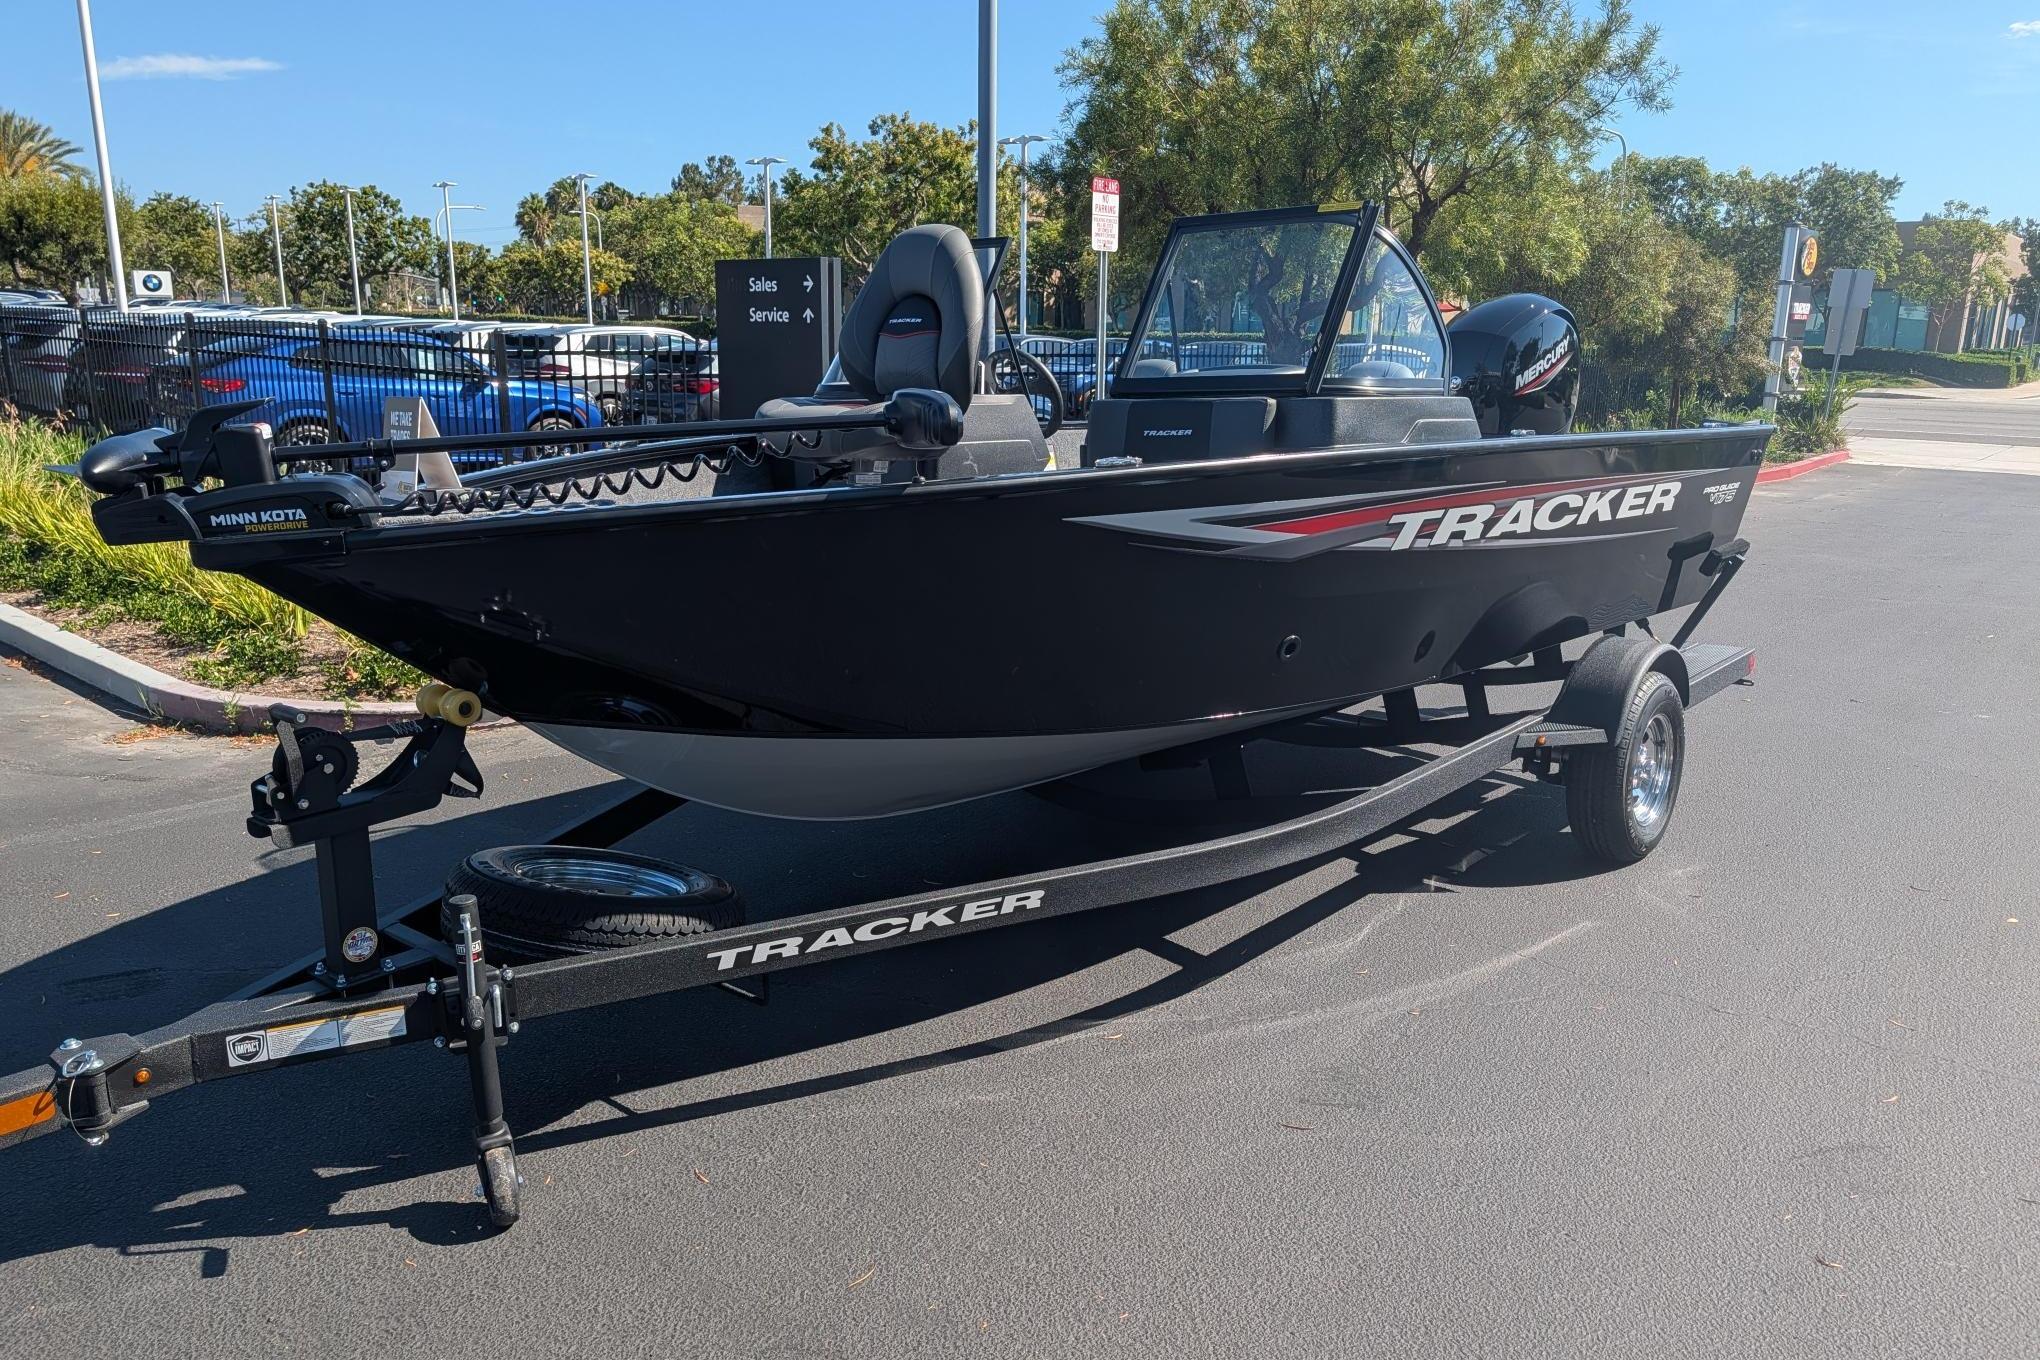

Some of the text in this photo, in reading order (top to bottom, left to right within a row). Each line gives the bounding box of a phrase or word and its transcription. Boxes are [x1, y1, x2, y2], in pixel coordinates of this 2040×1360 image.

[1093, 179, 1118, 193] FIRE LANE
[1102, 194, 1110, 203] NO
[1094, 203, 1117, 214] PARKING
[749, 276, 778, 292] Sales
[749, 306, 790, 322] Service
[1515, 334, 1570, 390] MERCURY
[391, 411, 413, 426] WE TAKE
[1143, 429, 1193, 437] TRACKER
[1703, 481, 1741, 495] PRO GUIDE
[210, 508, 307, 527] MINN KOTA
[1389, 482, 1682, 551] TRACKER
[244, 520, 309, 533] POWERDRIVE
[706, 889, 1046, 971] TRACKER
[235, 1041, 259, 1055] IMPACT
